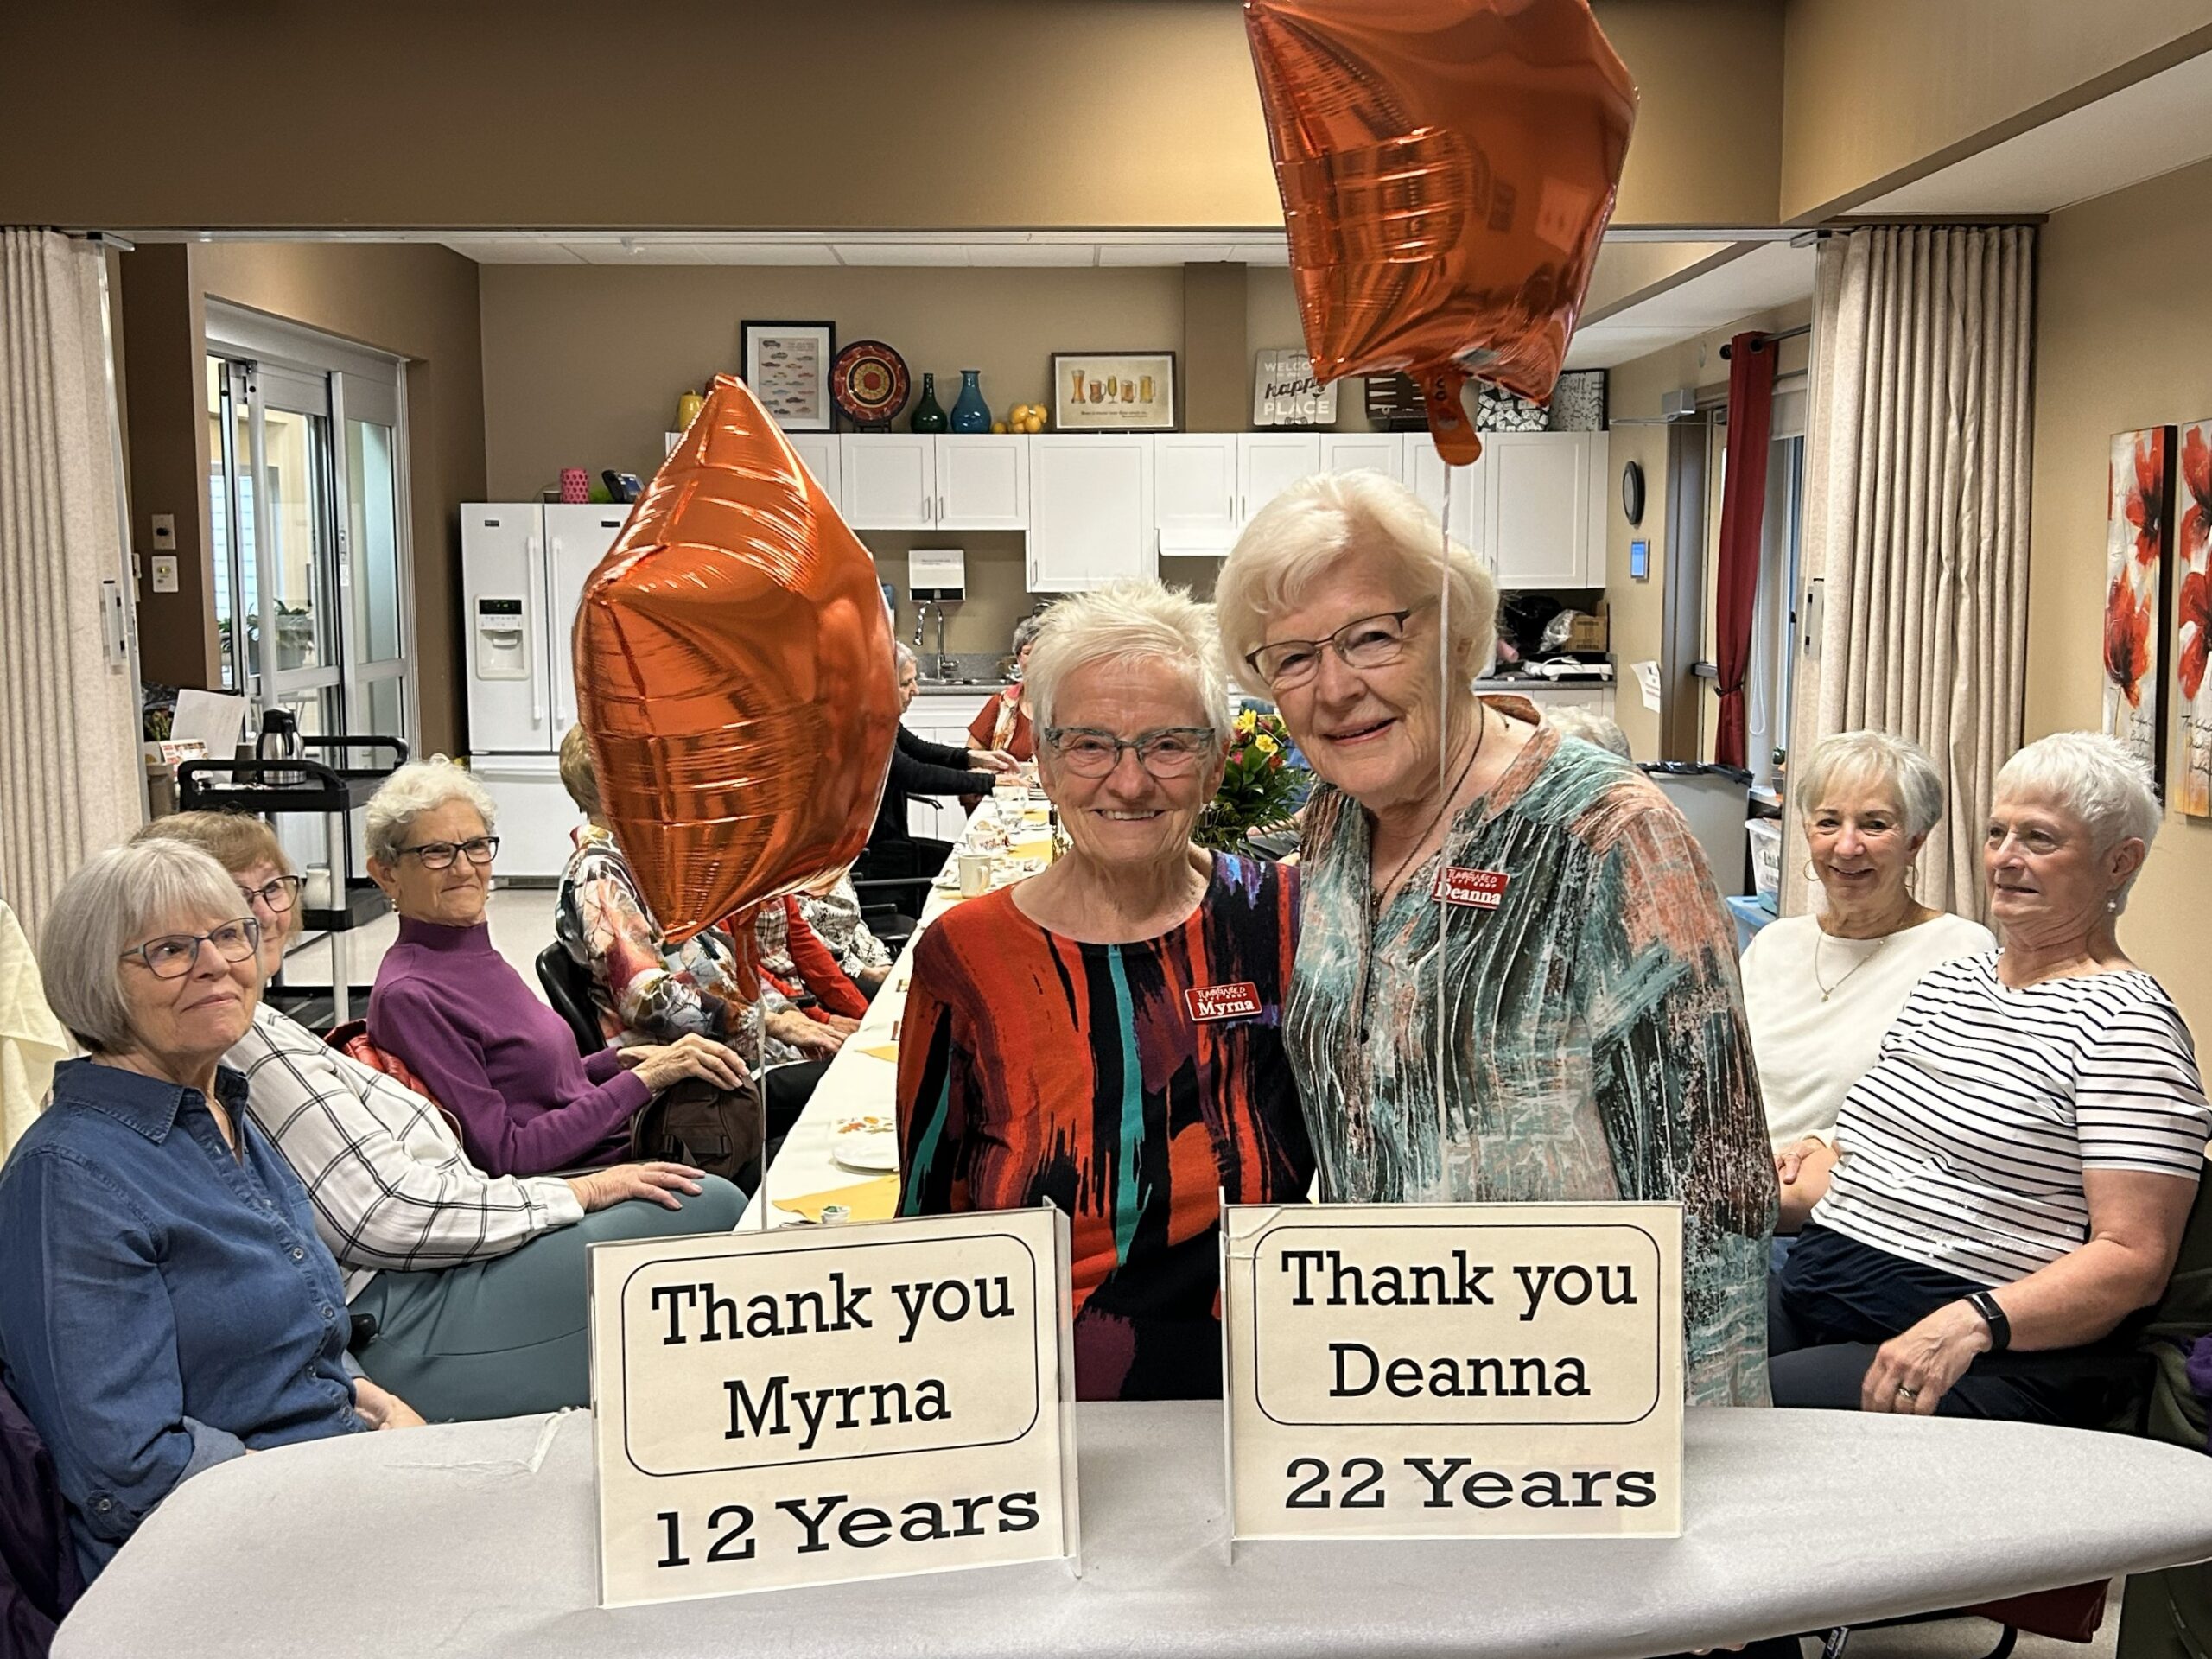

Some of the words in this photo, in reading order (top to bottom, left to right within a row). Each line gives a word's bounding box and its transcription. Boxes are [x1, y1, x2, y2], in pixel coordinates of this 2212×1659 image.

[1264, 362, 1312, 372] WELCO
[1264, 401, 1329, 415] PLACE
[1435, 882, 1501, 905] Deanna
[1197, 1000, 1255, 1016] Myrna
[652, 1272, 873, 1346] Thank
[891, 1276, 1014, 1344] you
[1282, 1250, 1494, 1306] Thank
[1514, 1265, 1637, 1322] you
[1329, 1343, 1591, 1398] Deanna
[724, 1376, 952, 1450] Myrna
[1285, 1457, 1385, 1509] 22
[1403, 1458, 1656, 1509] Years
[657, 1504, 755, 1568] 12
[775, 1491, 1039, 1554] Years
